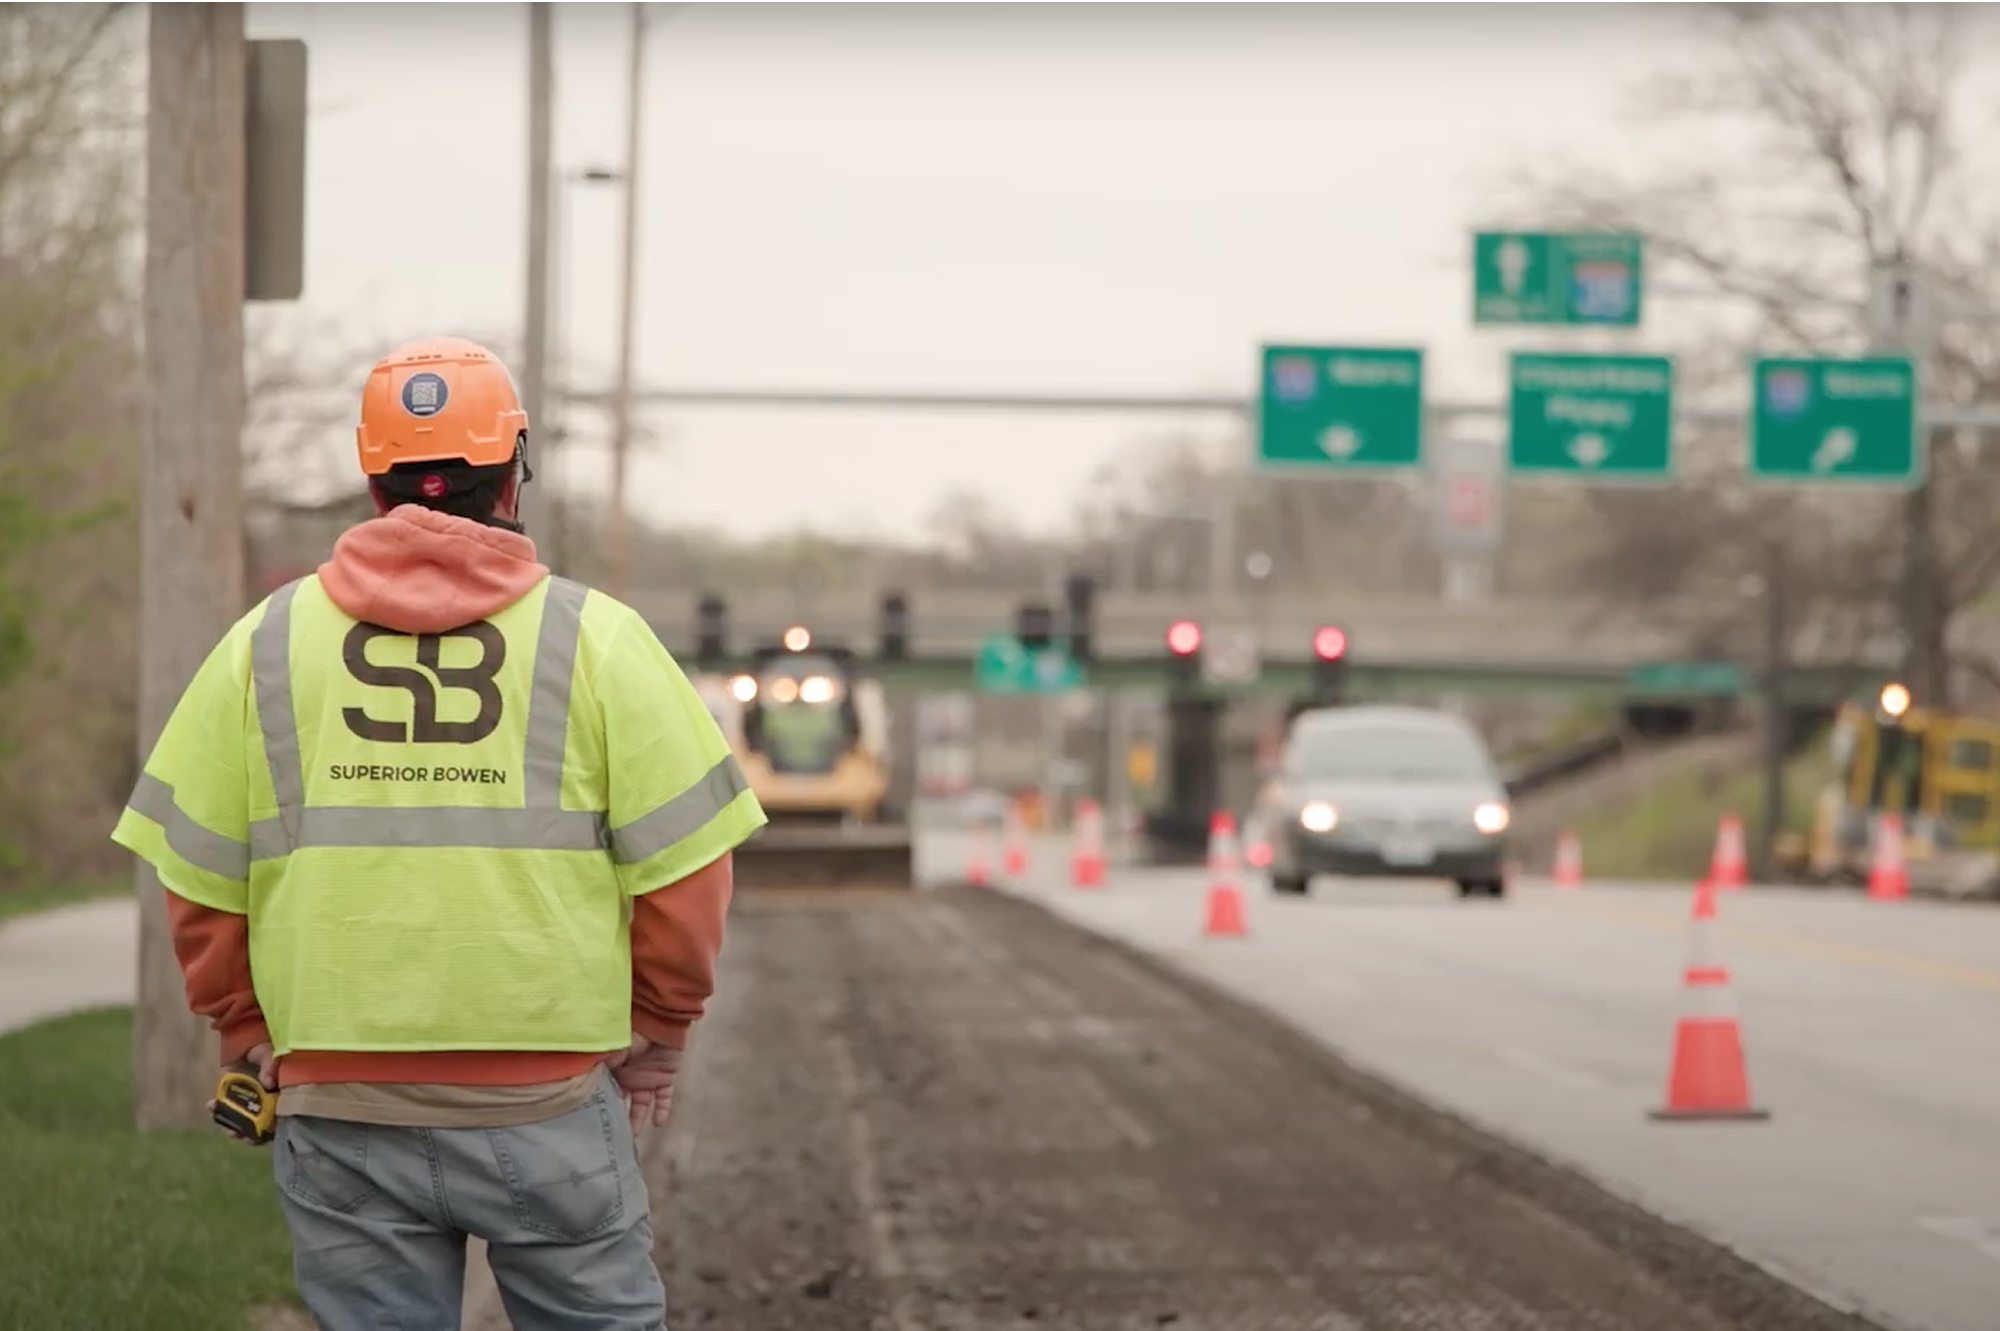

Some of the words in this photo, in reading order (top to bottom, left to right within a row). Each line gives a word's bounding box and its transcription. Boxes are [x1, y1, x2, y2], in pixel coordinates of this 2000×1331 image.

[342, 620, 506, 744] SB
[329, 765, 428, 783] SUPERIOR
[433, 767, 507, 784] BOWEN
